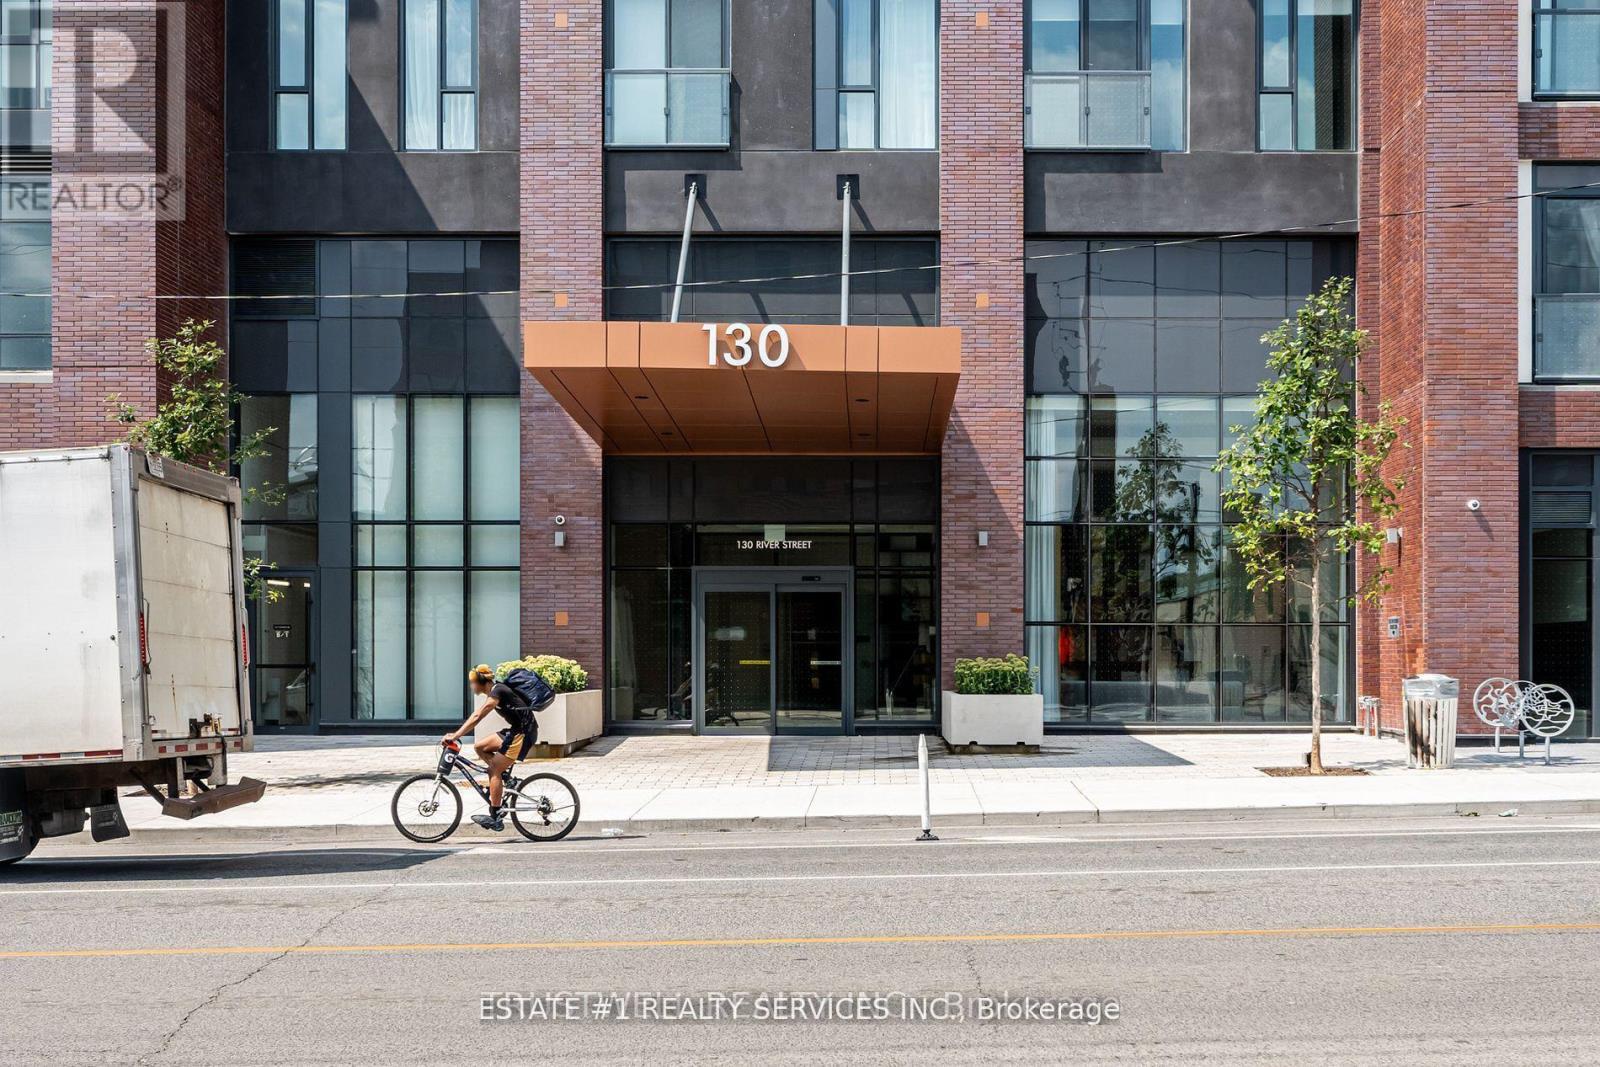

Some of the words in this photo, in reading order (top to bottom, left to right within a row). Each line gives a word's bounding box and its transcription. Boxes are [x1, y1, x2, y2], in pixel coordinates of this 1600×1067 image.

[701, 323, 789, 367] 130
[737, 540, 753, 549] 130
[756, 540, 780, 549] RIVER
[782, 540, 812, 549] STREET
